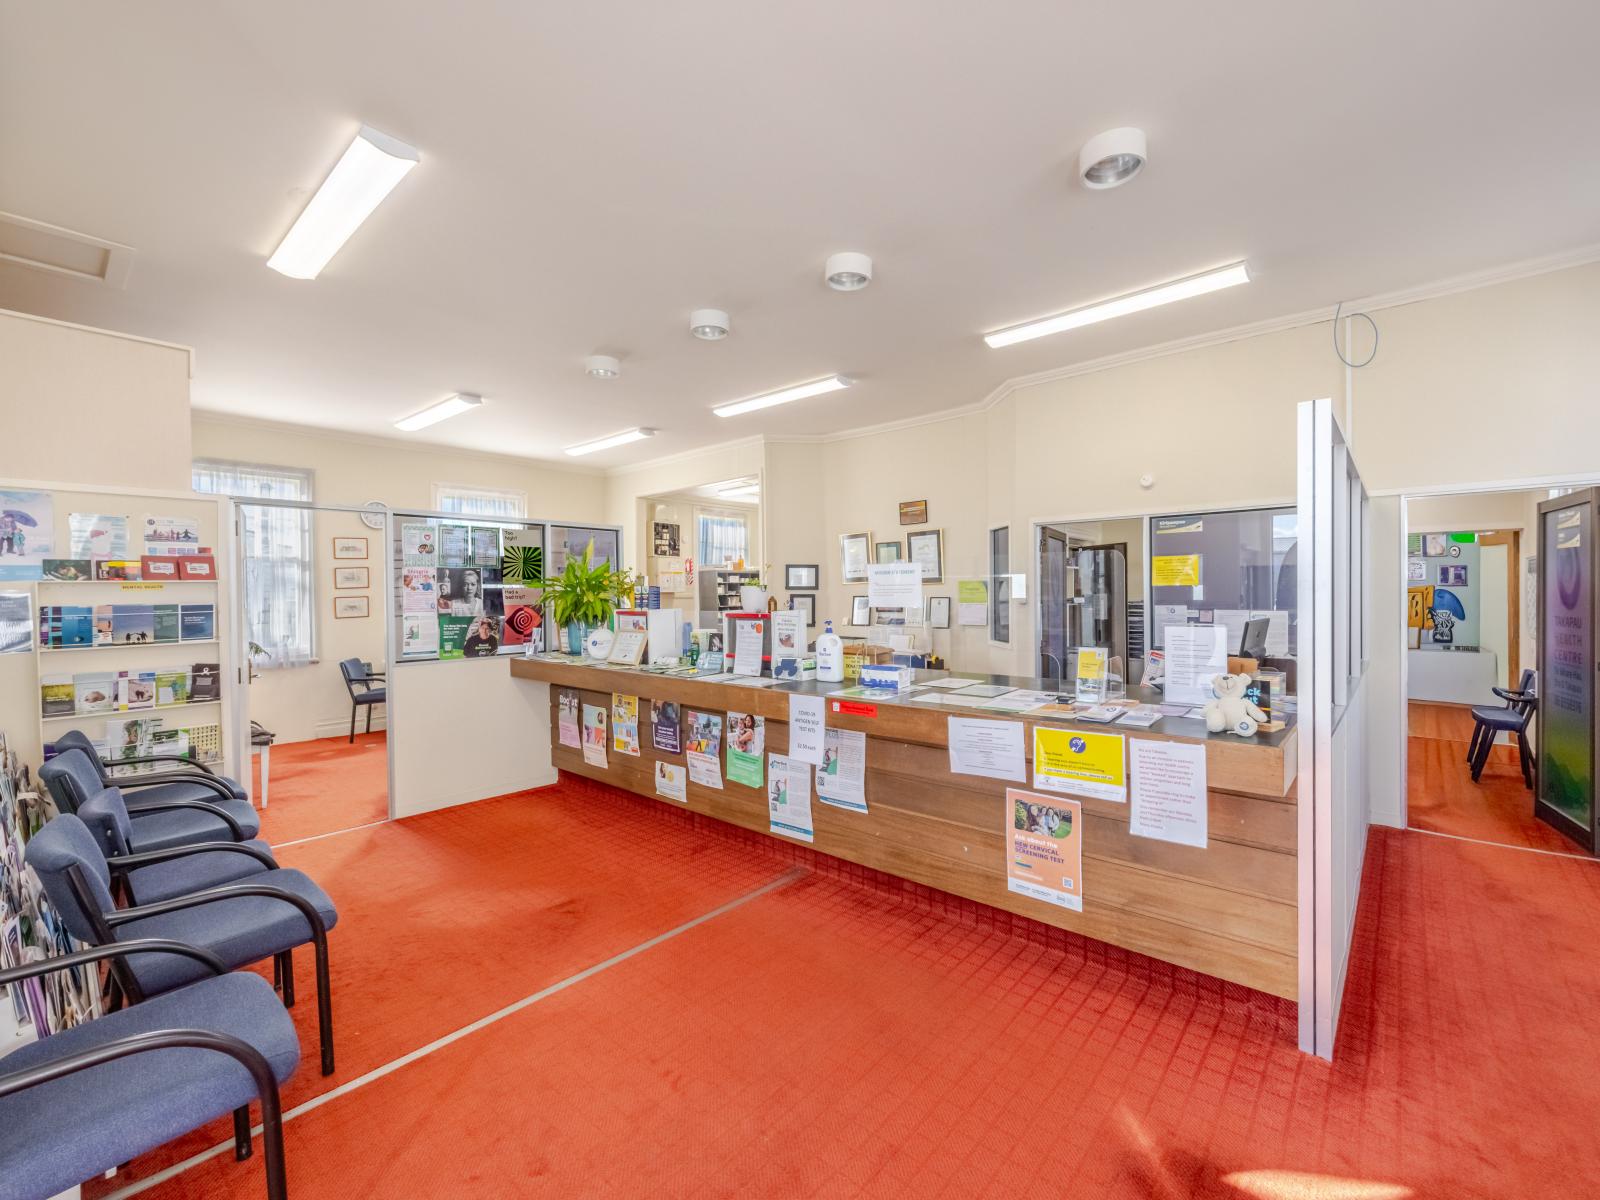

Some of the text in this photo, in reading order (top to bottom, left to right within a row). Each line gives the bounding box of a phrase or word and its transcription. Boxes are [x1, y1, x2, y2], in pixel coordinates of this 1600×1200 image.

[1553, 648, 1582, 665] CENTRE
[1015, 840, 1060, 856] NEW CERVICAL
[1015, 846, 1065, 864] SCREENING TEST
